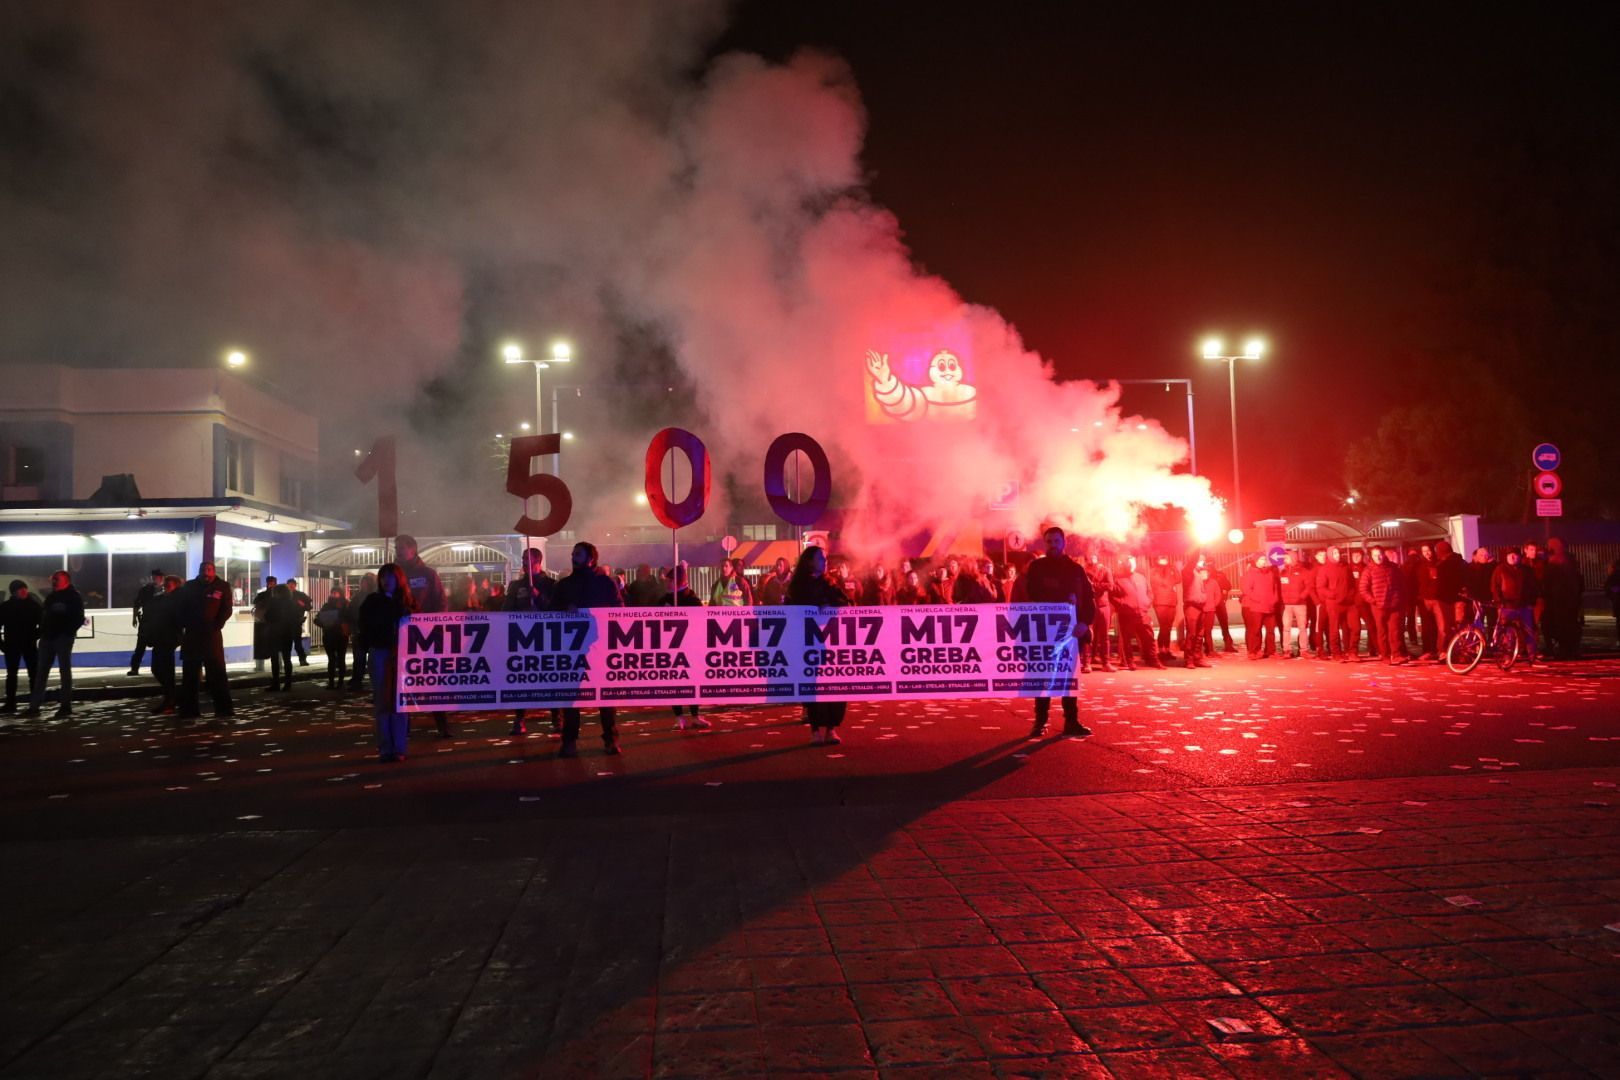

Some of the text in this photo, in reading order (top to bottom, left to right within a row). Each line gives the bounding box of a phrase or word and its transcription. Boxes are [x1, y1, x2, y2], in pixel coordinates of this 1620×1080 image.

[508, 621, 590, 652] M17
[608, 619, 688, 650] M17
[707, 618, 787, 648] M17
[804, 617, 883, 646] M17
[901, 615, 978, 645] M17
[996, 613, 1071, 643] M17
[408, 623, 489, 654] M17
[506, 654, 591, 672] GREBA
[606, 652, 690, 670] GREBA
[705, 651, 789, 668] GREBA
[803, 649, 886, 666] GREBA
[901, 647, 982, 664] GREBA
[406, 657, 491, 674] GREBA
[705, 668, 788, 679] OROKORRA
[803, 666, 886, 677] OROKORRA
[901, 664, 981, 675] OROKORRA
[405, 675, 490, 686] OROKORRA
[506, 672, 590, 684] OROKORRA
[606, 670, 690, 681] OROKORRA
